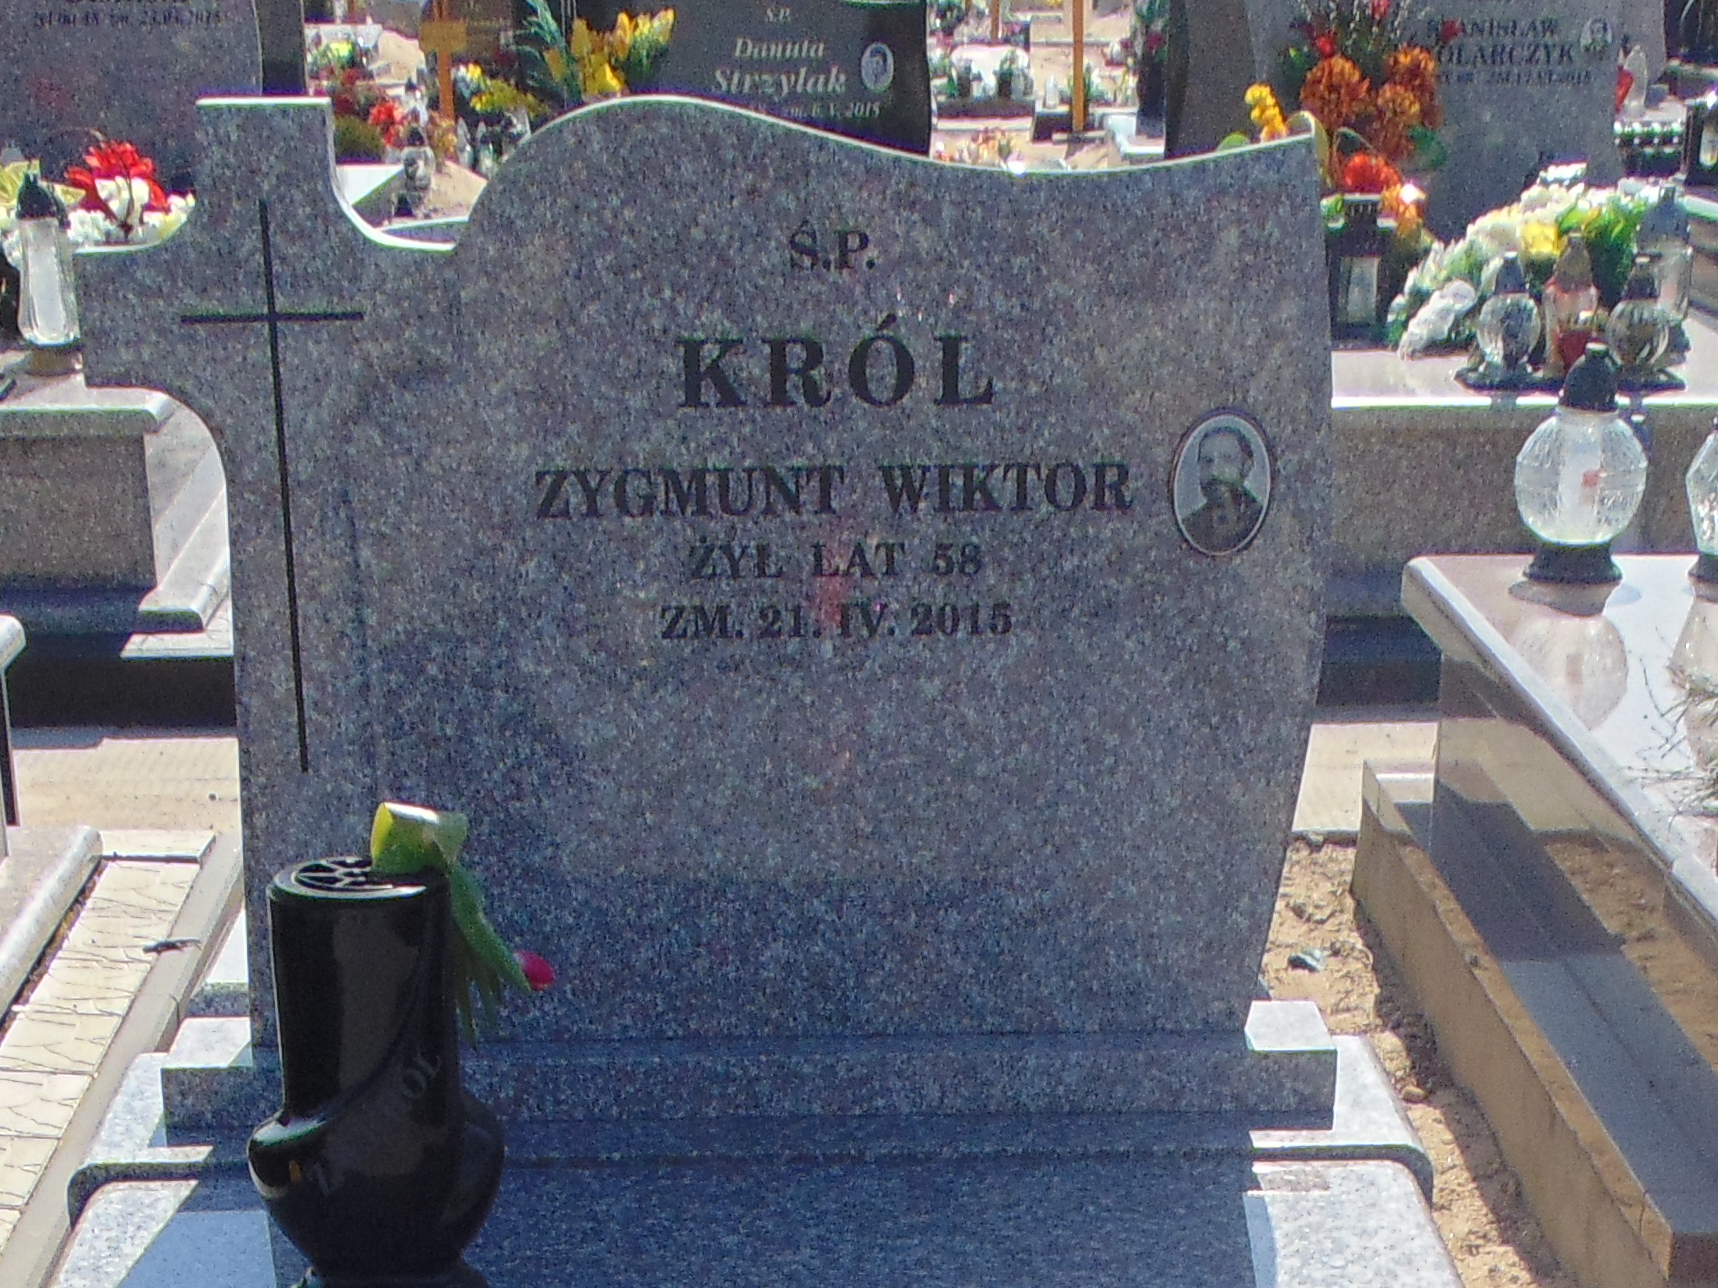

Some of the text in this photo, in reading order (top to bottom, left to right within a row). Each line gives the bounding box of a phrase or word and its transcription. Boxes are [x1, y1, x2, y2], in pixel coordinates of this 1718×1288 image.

[733, 36, 825, 61] Danuta
[674, 312, 995, 409] KRÓL
[534, 461, 1134, 520] ZYGMUNT WIKTOR
[810, 541, 907, 578] LAT
[933, 543, 984, 578] 58
[660, 601, 1014, 640] ZM. 21. IV. 2015
